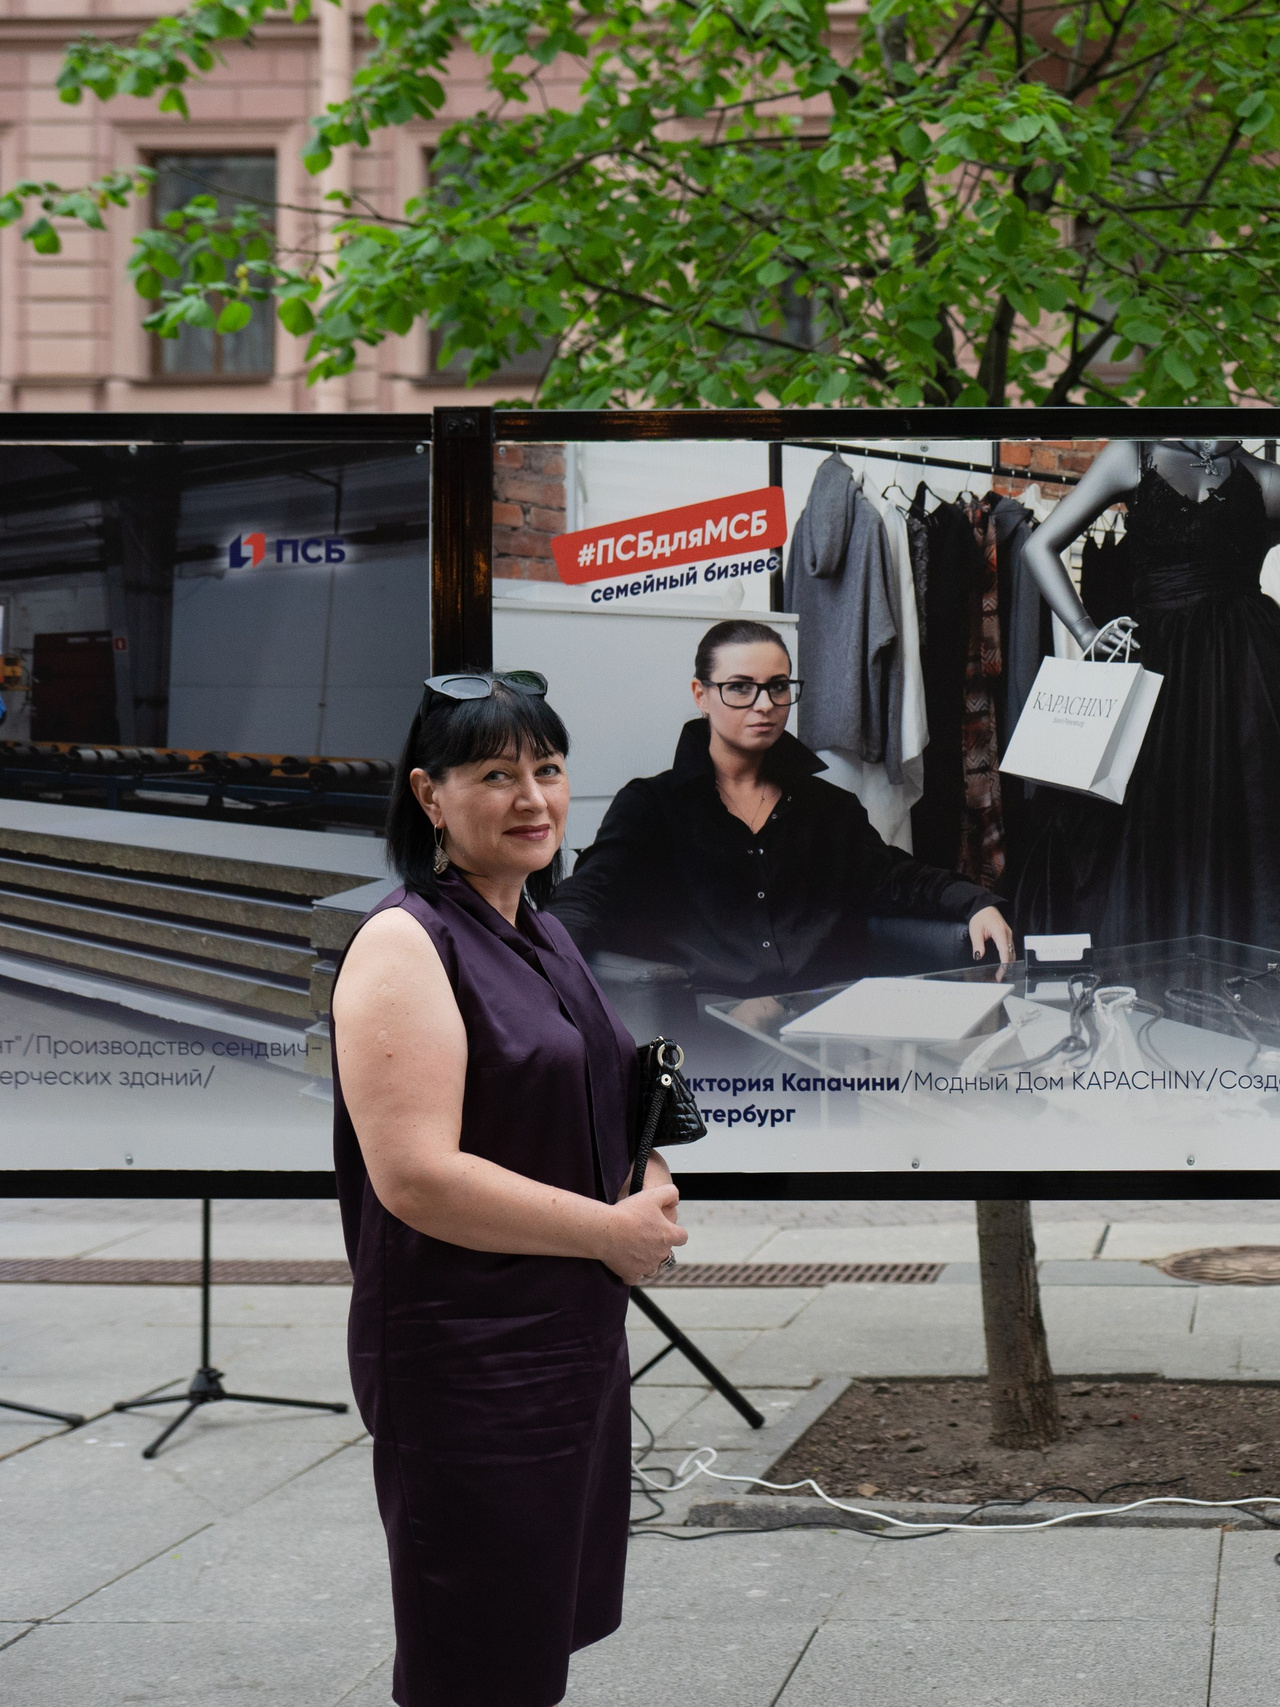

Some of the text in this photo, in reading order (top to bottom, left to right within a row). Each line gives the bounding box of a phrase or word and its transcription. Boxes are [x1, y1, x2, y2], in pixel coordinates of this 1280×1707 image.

[275, 537, 347, 564] ПСБ
[577, 509, 769, 567] #ПСБдляМСБ
[590, 555, 779, 604] семейный бизнес
[1032, 691, 1119, 718] KAPACHINY
[0, 1033, 205, 1059] т"/Производство
[119, 1065, 217, 1090] зданий/
[1015, 1071, 1064, 1094] Дом
